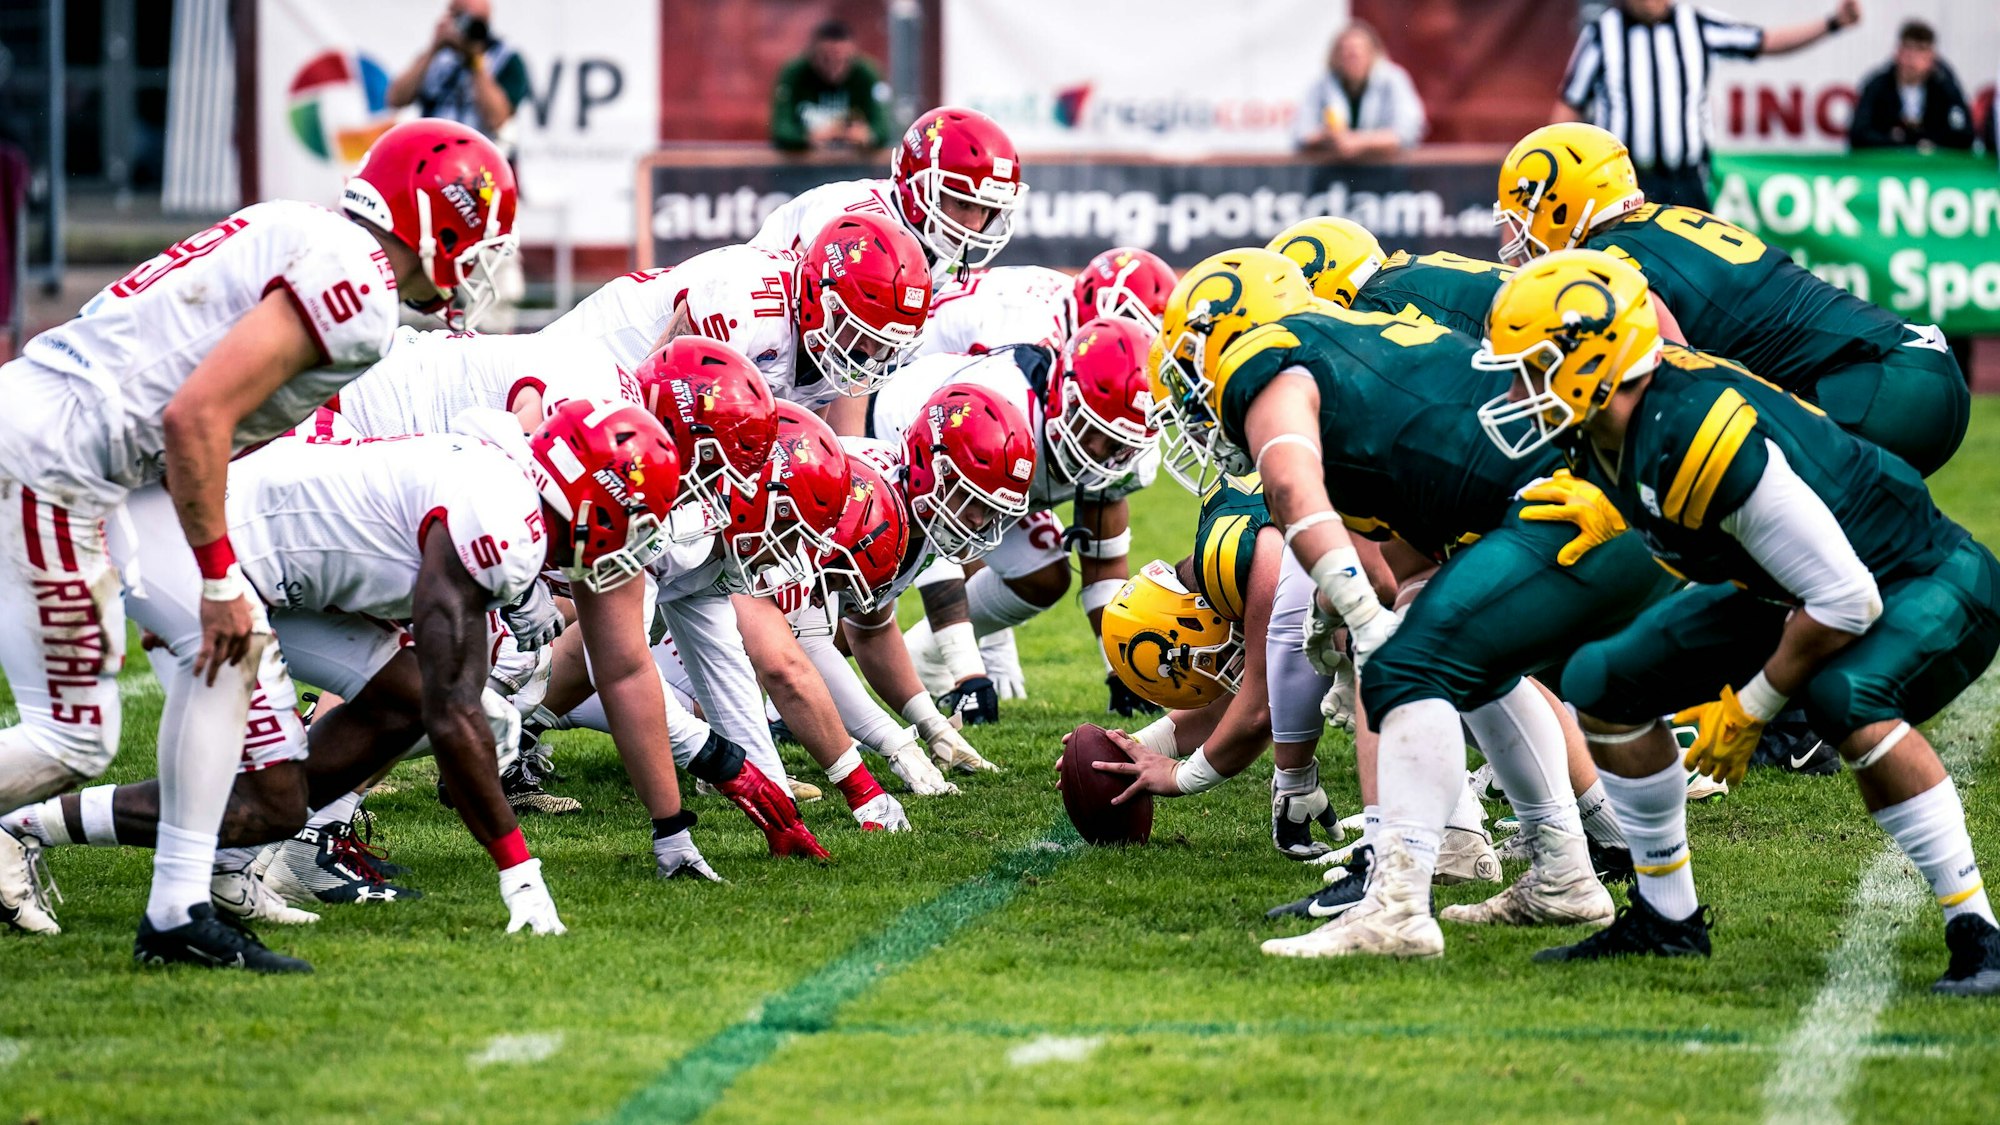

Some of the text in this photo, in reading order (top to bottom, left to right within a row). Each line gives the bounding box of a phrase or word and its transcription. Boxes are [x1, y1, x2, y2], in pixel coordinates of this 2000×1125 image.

[1713, 173, 2000, 238] AOK Nor
[824, 242, 847, 278] ROYALS
[669, 379, 695, 423] ROYALS
[592, 469, 632, 506] ROYALS
[32, 579, 103, 725] ROYALS
